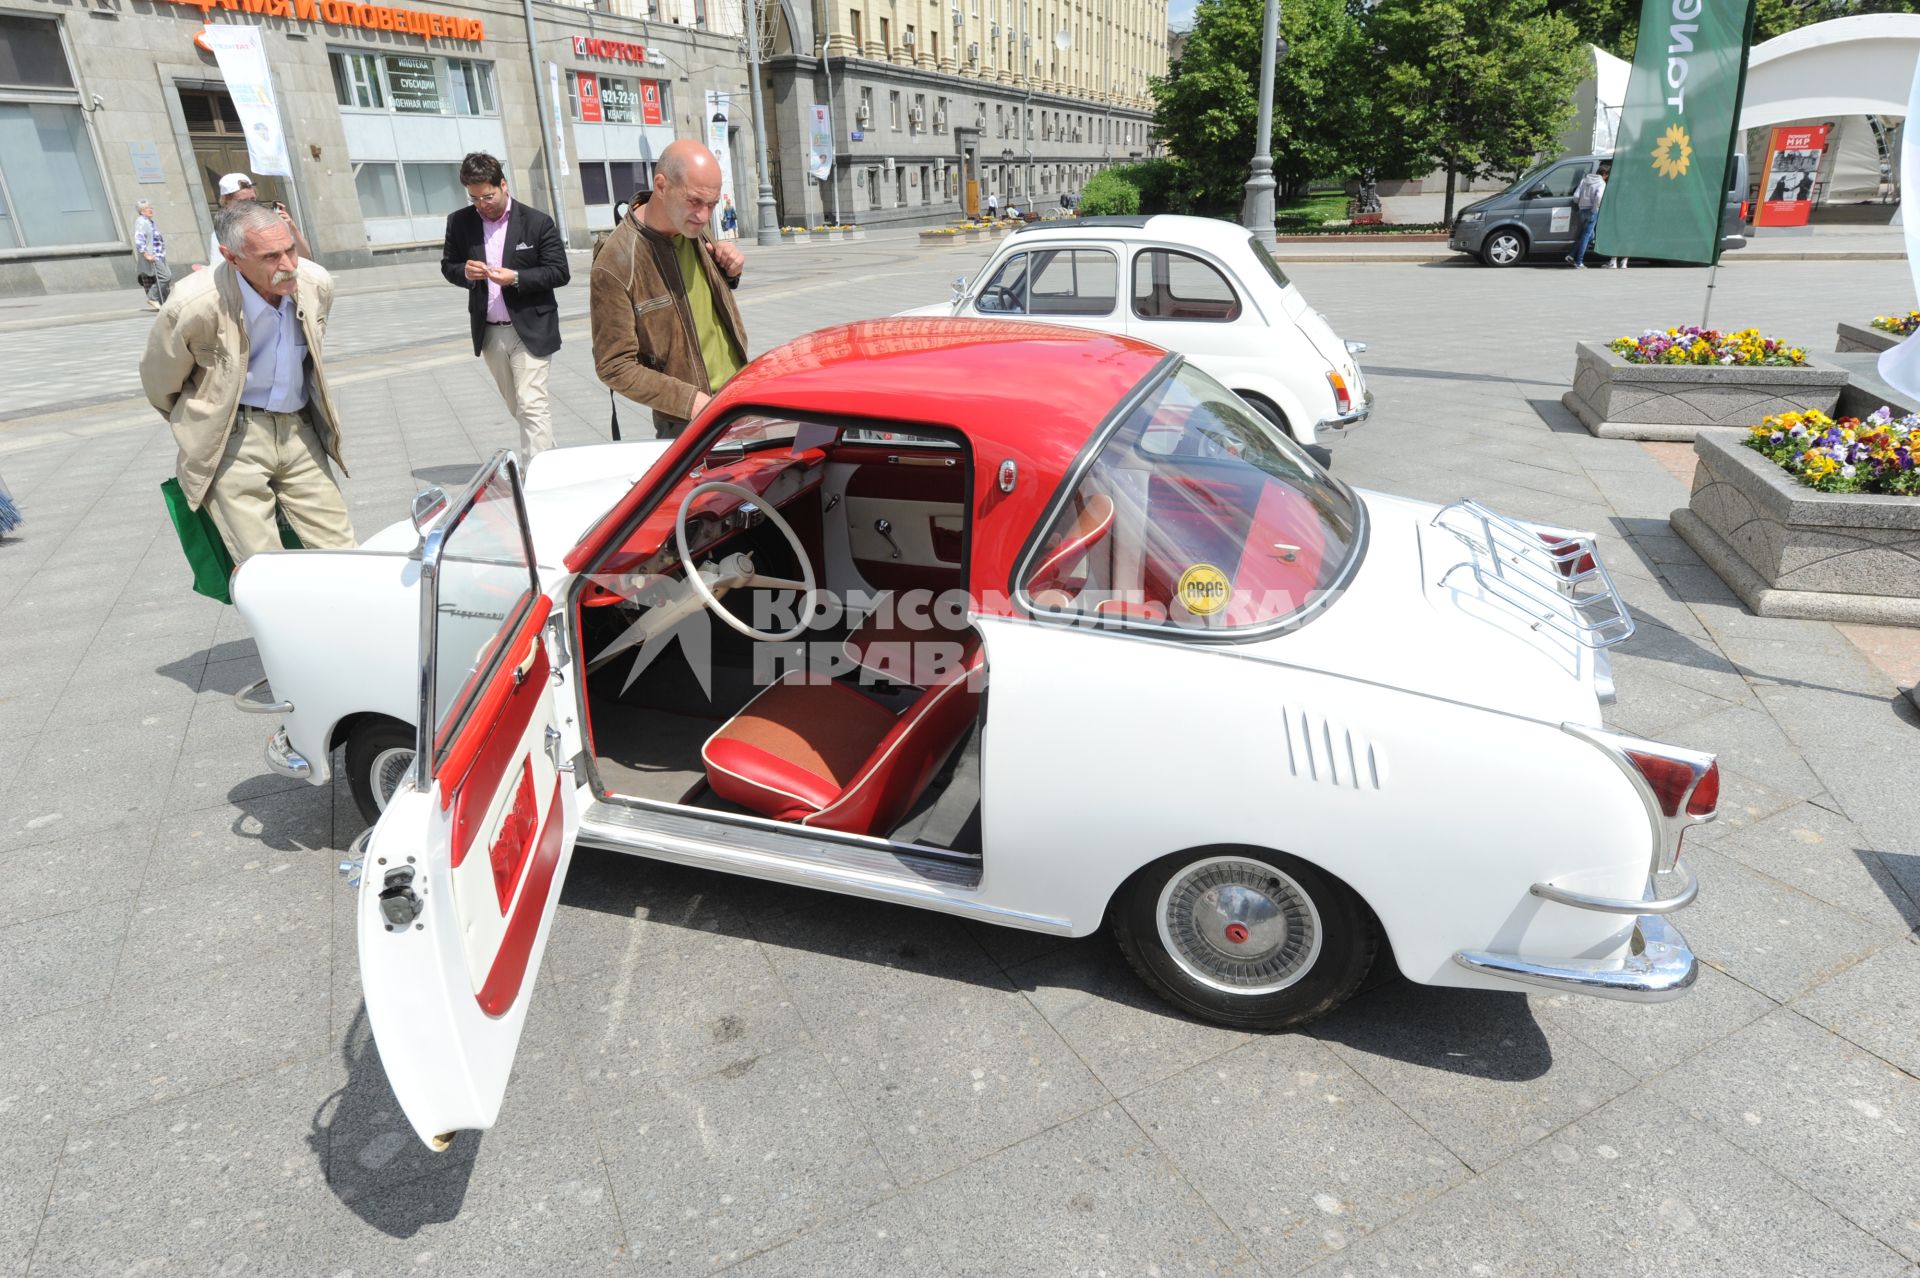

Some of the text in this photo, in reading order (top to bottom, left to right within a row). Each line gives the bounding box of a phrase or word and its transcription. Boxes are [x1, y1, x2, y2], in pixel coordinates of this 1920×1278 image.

[293, 0, 318, 20] И
[320, 2, 486, 41] ОПОВЕЩЕНИЯ
[585, 37, 645, 62] МОРТОН
[398, 59, 429, 70] ИПОТЕКА
[400, 79, 435, 90] СУБСИДИИ
[601, 89, 639, 105] 921-22-21
[1786, 138, 1810, 146] МИР
[1187, 581, 1223, 599] ARAG
